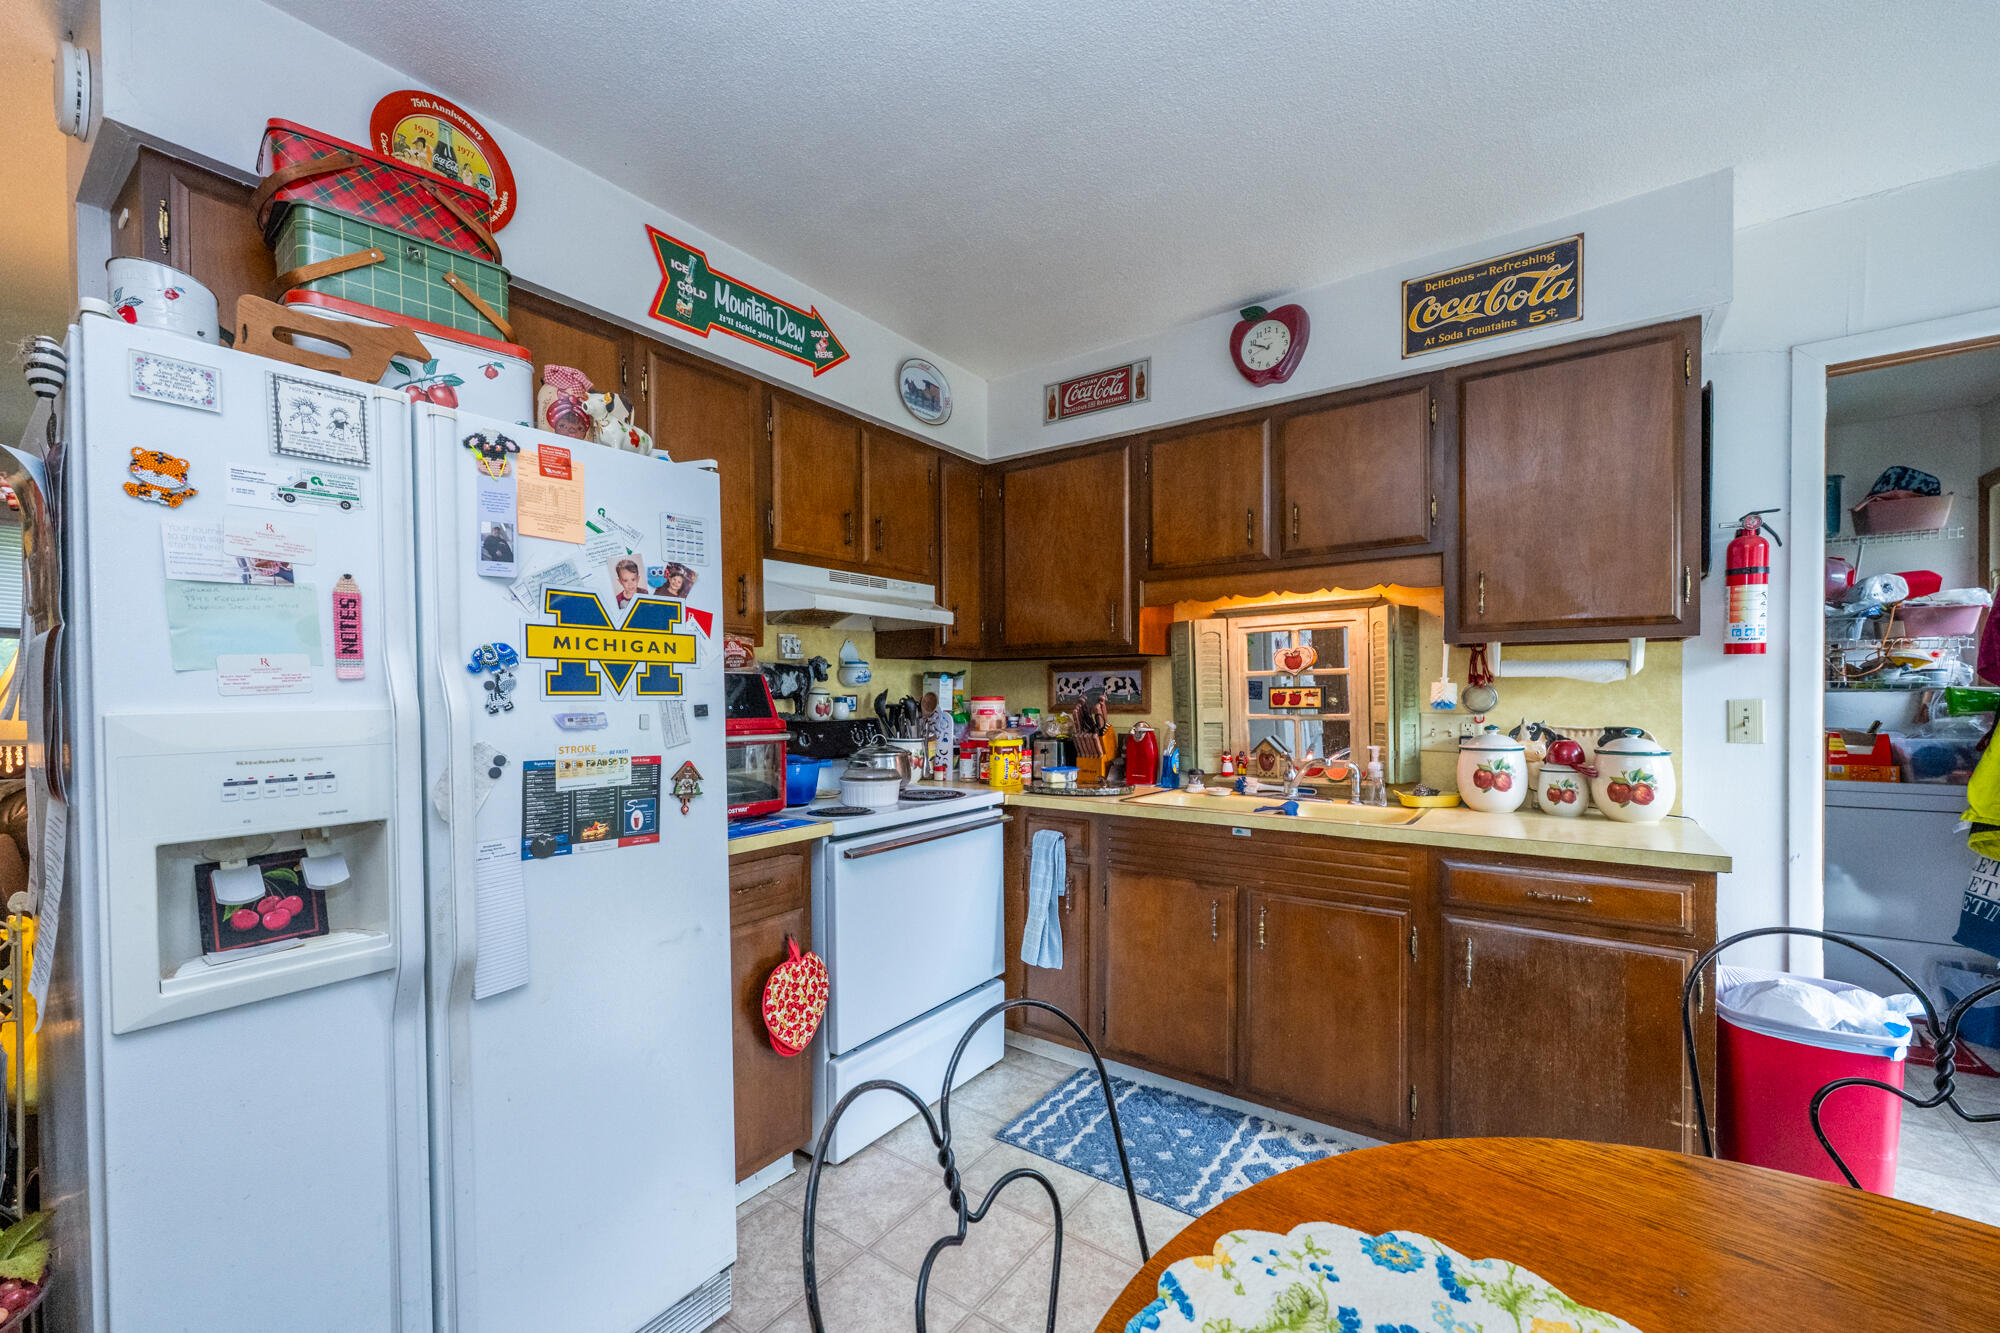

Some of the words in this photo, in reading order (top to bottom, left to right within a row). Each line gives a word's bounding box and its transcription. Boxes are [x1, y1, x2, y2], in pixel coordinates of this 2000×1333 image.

[411, 98, 430, 108] 75th
[432, 100, 484, 140] Anniversary
[414, 124, 434, 139] 1902
[670, 258, 690, 274] ICE
[1425, 273, 1475, 292] Delicious
[1489, 251, 1556, 276] Refreshing
[677, 280, 708, 300] COLD
[1408, 260, 1575, 333] Coca-Cola
[714, 280, 774, 330] Mountain
[773, 306, 806, 344] Dew
[719, 313, 734, 326] It'll
[735, 320, 757, 336] tickle
[758, 330, 774, 344] yore
[774, 336, 802, 353] innards!
[810, 330, 829, 338] SOLD
[1424, 336, 1436, 346] At
[1438, 330, 1464, 344] Soda
[1466, 317, 1518, 336] Fountains
[1064, 372, 1126, 408] Coca-Cola
[339, 598, 358, 655] NOTES
[552, 636, 678, 654] MICHIGAN
[558, 744, 597, 755] STROKE
